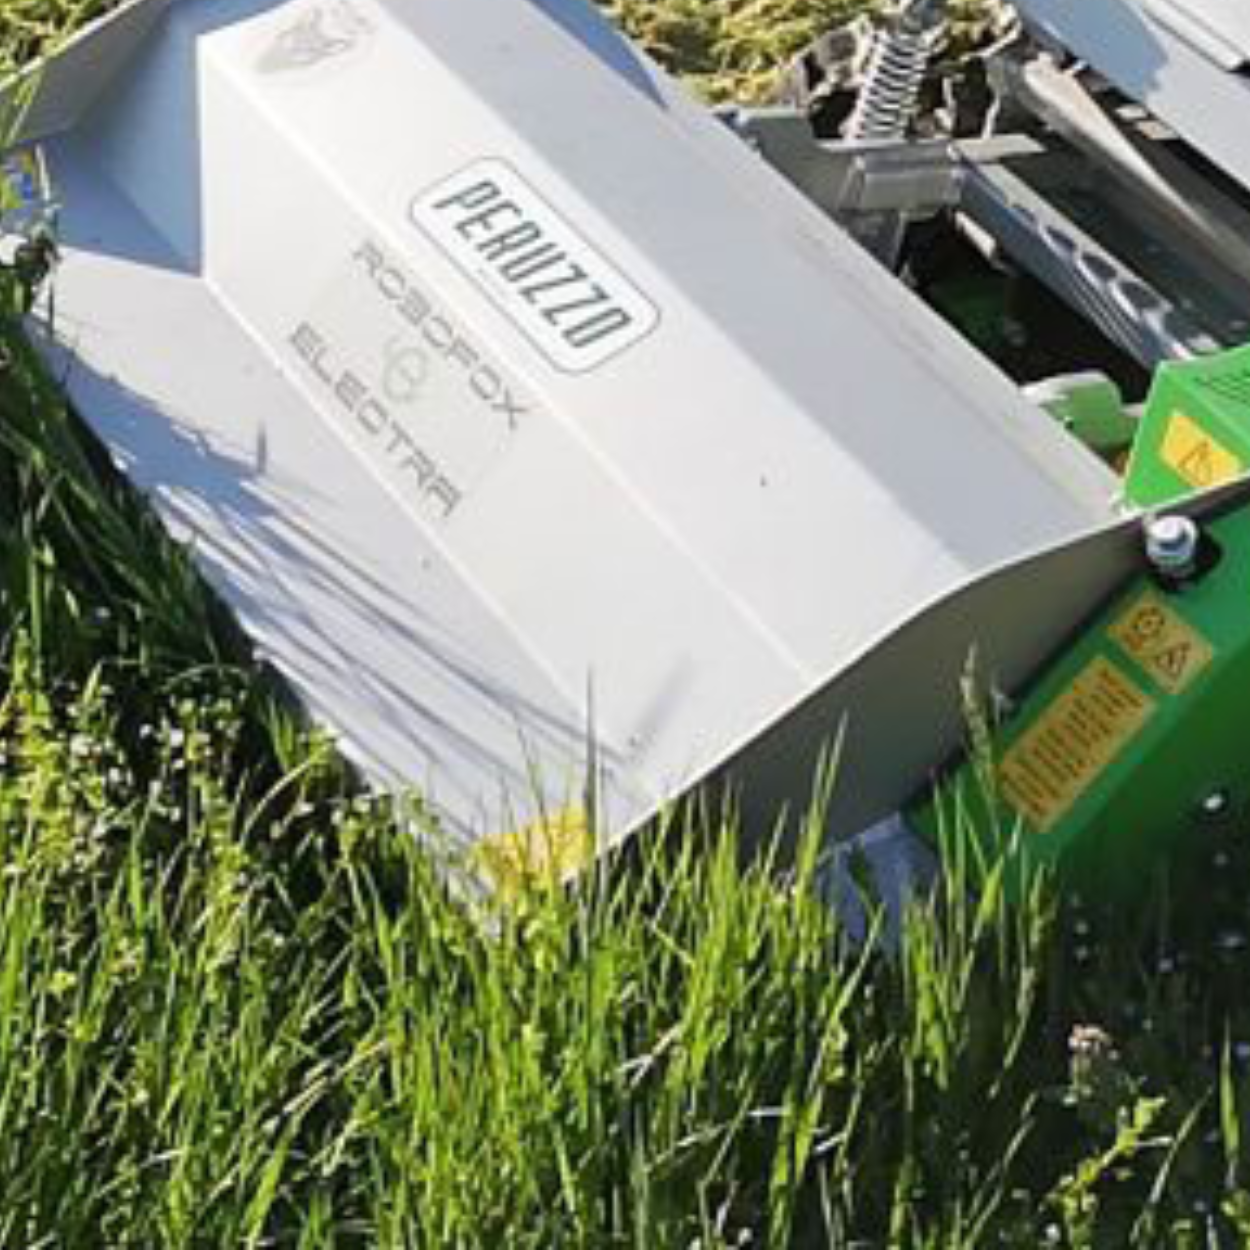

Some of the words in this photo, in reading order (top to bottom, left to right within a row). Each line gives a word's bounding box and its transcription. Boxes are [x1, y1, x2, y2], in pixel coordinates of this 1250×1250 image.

[353, 240, 528, 429] ROBOFOX
[432, 179, 632, 348] PERUZZO
[290, 322, 461, 517] ELECTRA
